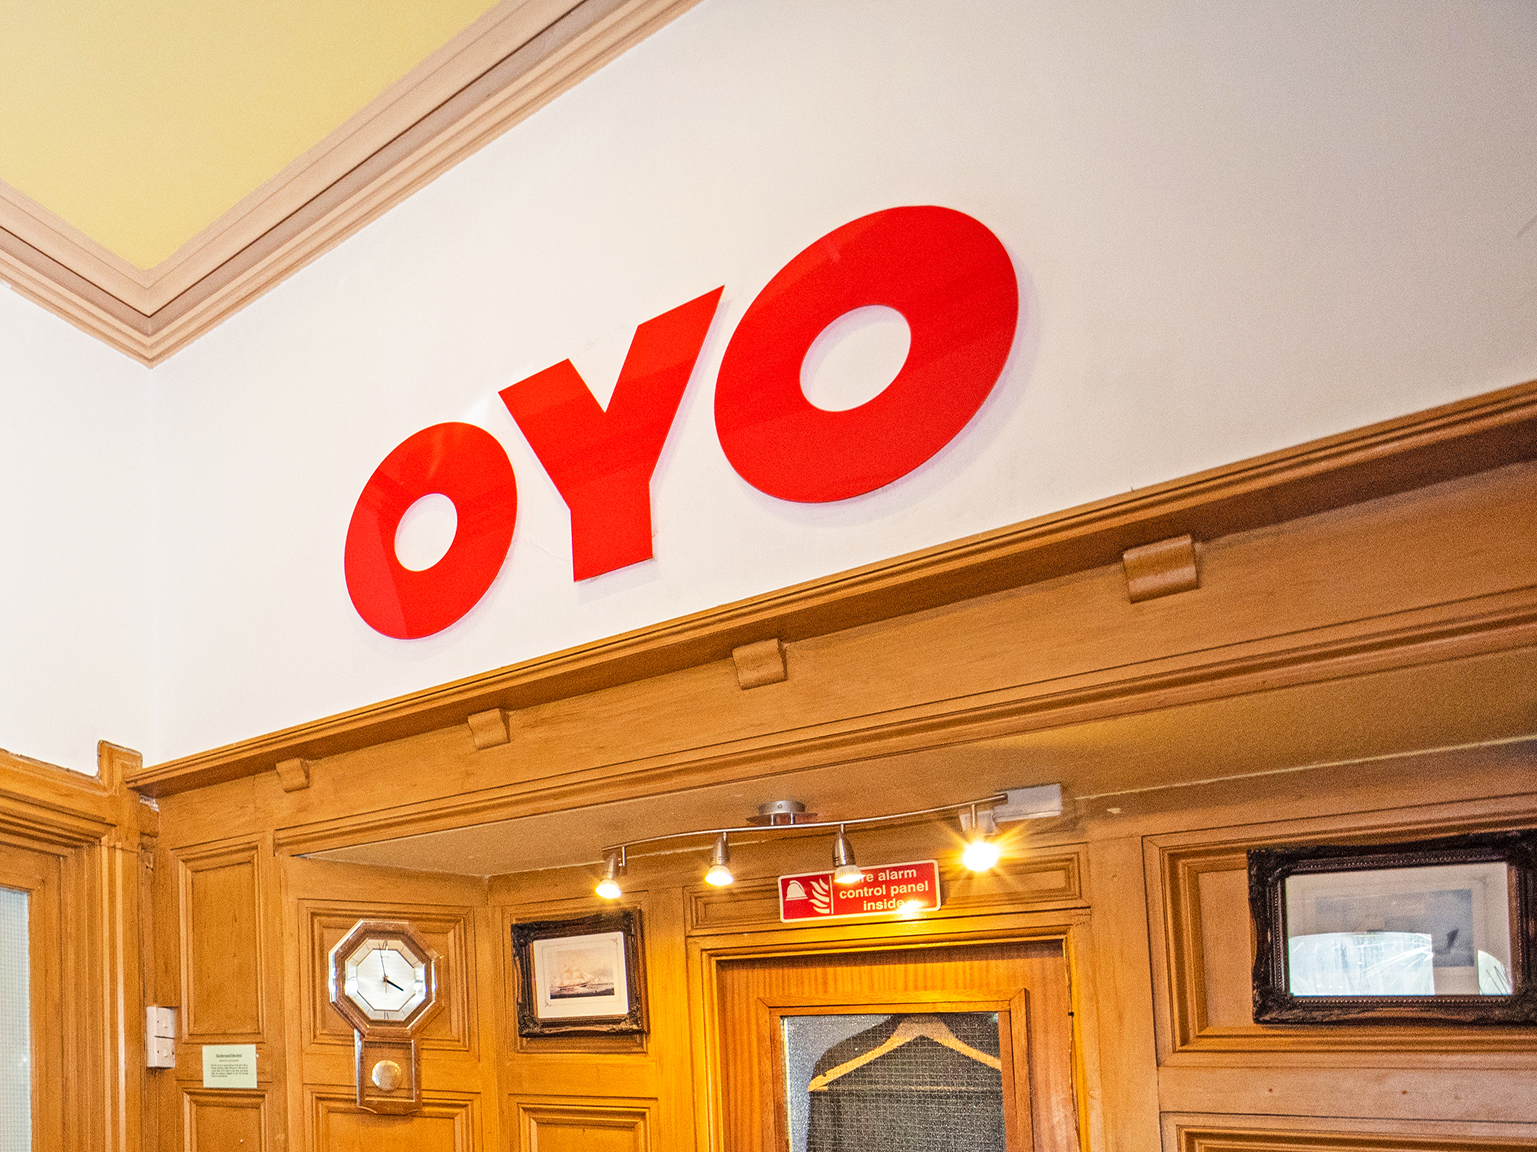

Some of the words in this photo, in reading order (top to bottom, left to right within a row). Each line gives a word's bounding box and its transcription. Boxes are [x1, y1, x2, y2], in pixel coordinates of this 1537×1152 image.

[344, 205, 1019, 640] OYO
[878, 869, 917, 881] alarm
[839, 884, 886, 899] control
[890, 880, 929, 897] panel
[863, 898, 905, 911] inside
